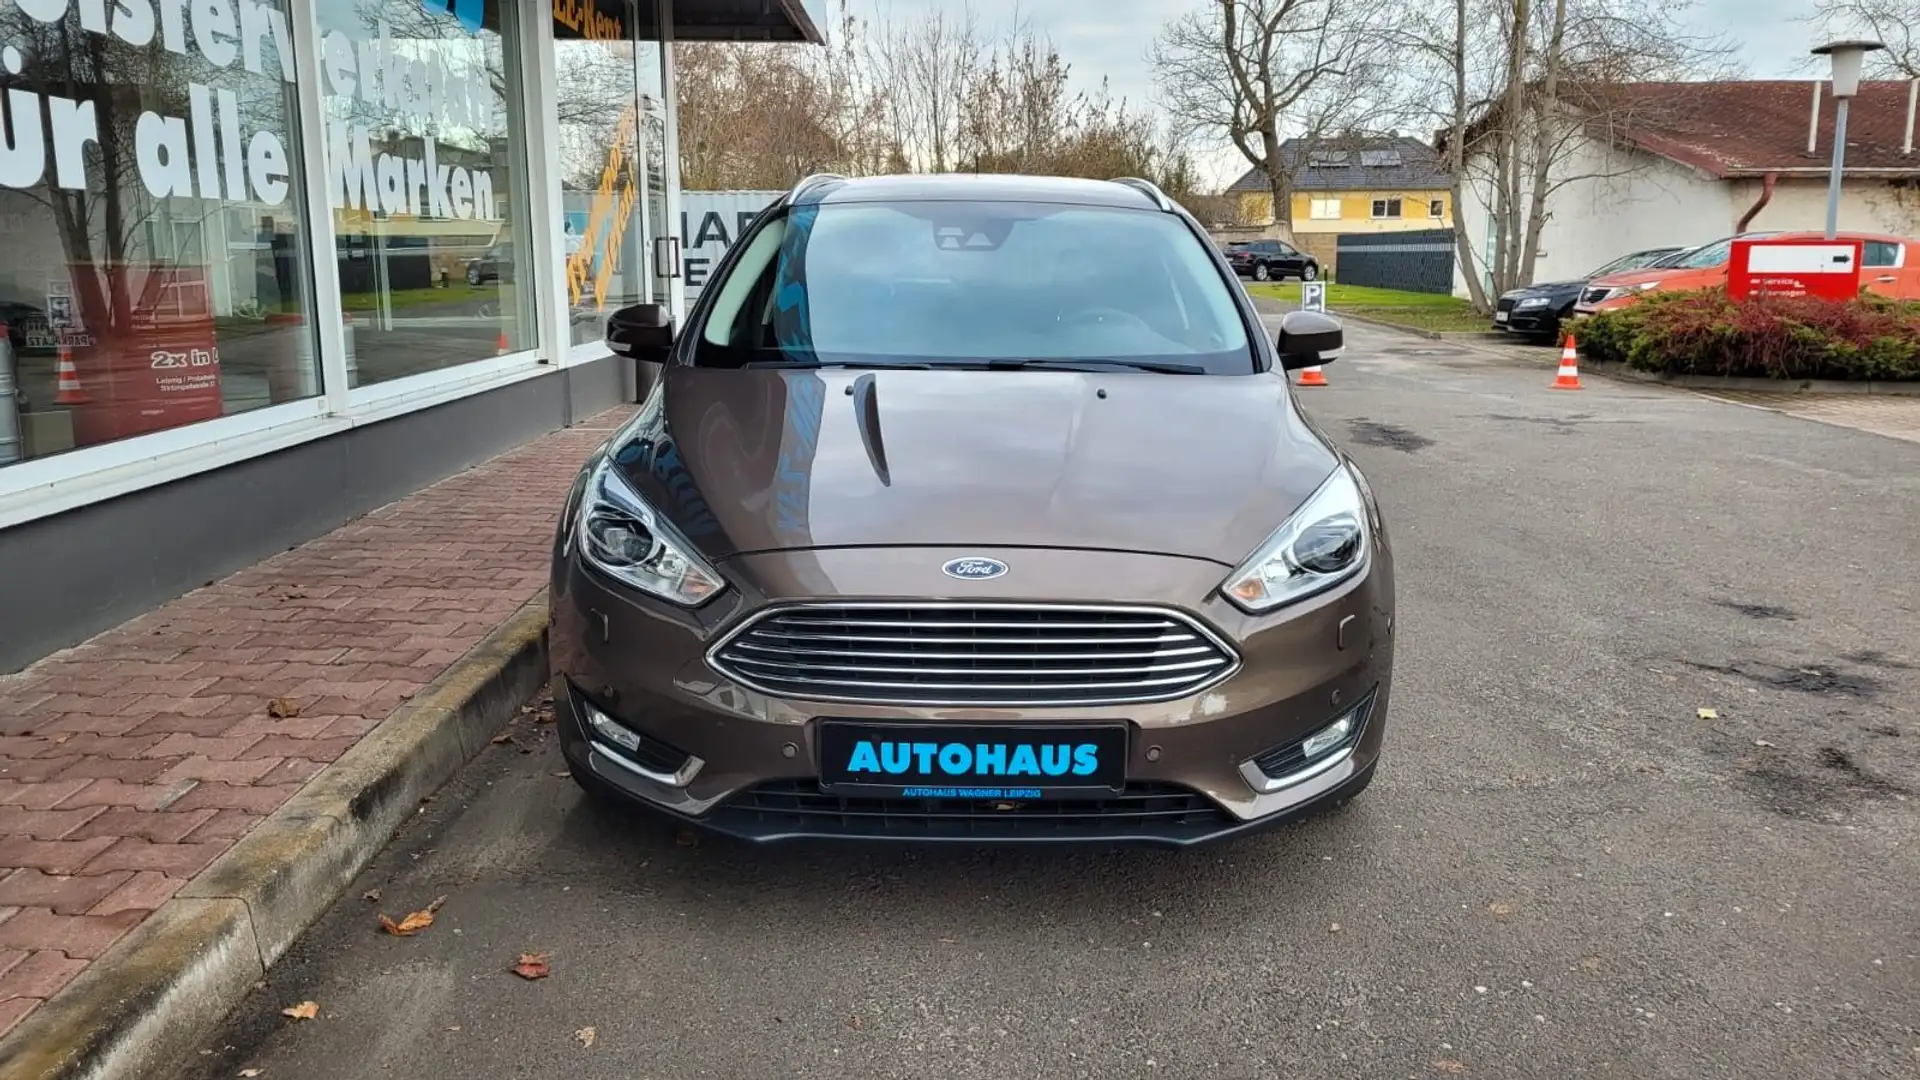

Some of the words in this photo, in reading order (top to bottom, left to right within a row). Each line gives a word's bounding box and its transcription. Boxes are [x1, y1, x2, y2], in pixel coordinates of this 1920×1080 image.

[135, 82, 289, 206] alle
[327, 120, 497, 221] Marken
[1305, 285, 1320, 304] P
[151, 350, 188, 368] 2x
[191, 349, 210, 366] in
[847, 741, 1099, 776] AUTOHAUS
[903, 788, 957, 797] AUTOHAUS
[959, 789, 1001, 797] WAGNER
[1004, 789, 1041, 798] LEIPZIG
